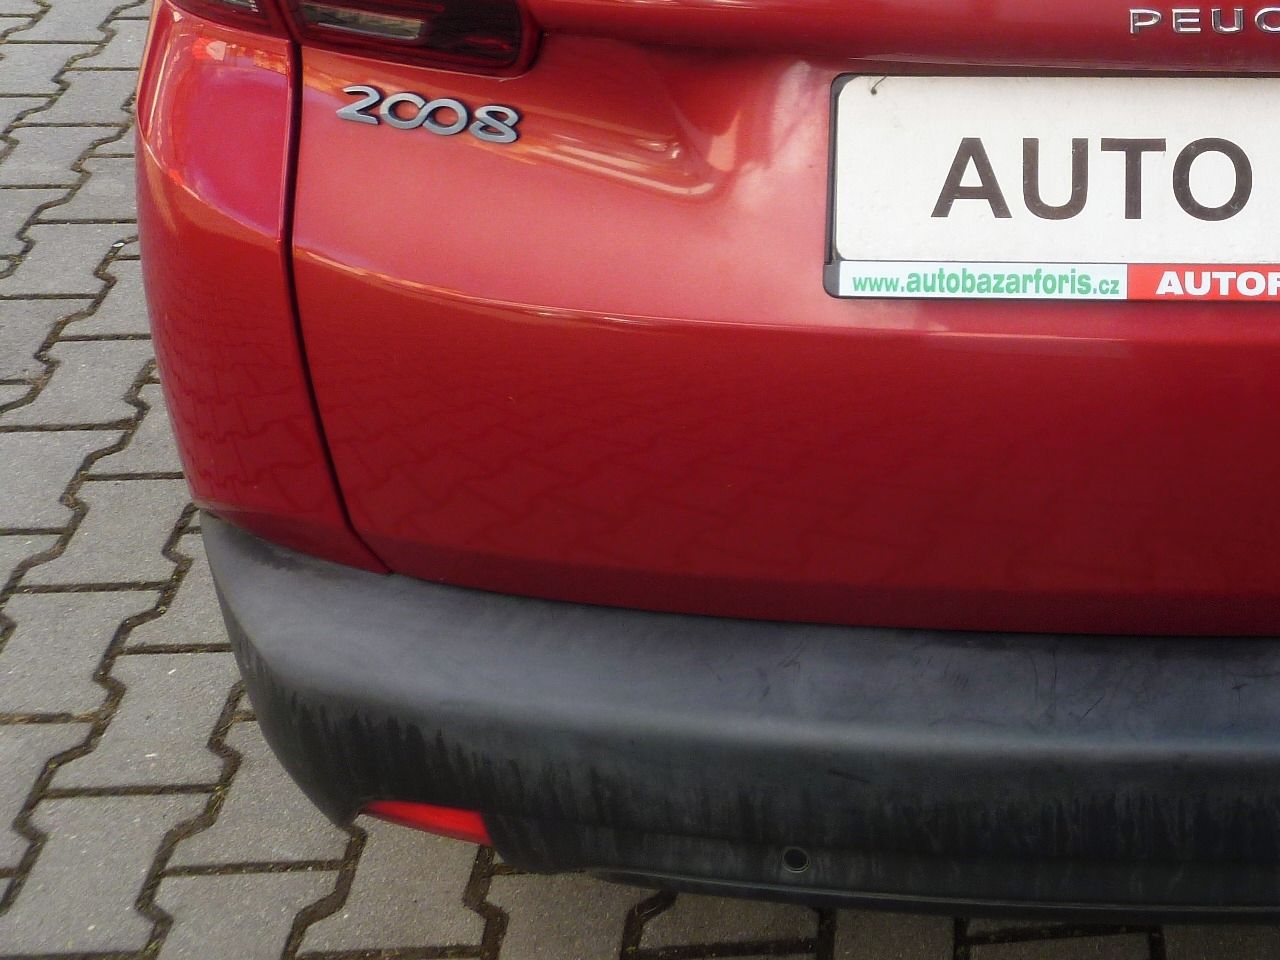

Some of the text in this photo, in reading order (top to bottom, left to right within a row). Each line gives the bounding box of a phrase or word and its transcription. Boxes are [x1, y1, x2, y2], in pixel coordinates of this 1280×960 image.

[335, 85, 520, 144] 2008
[931, 136, 1253, 222] AUTO
[852, 267, 1120, 296] www.autobazarforis.cz
